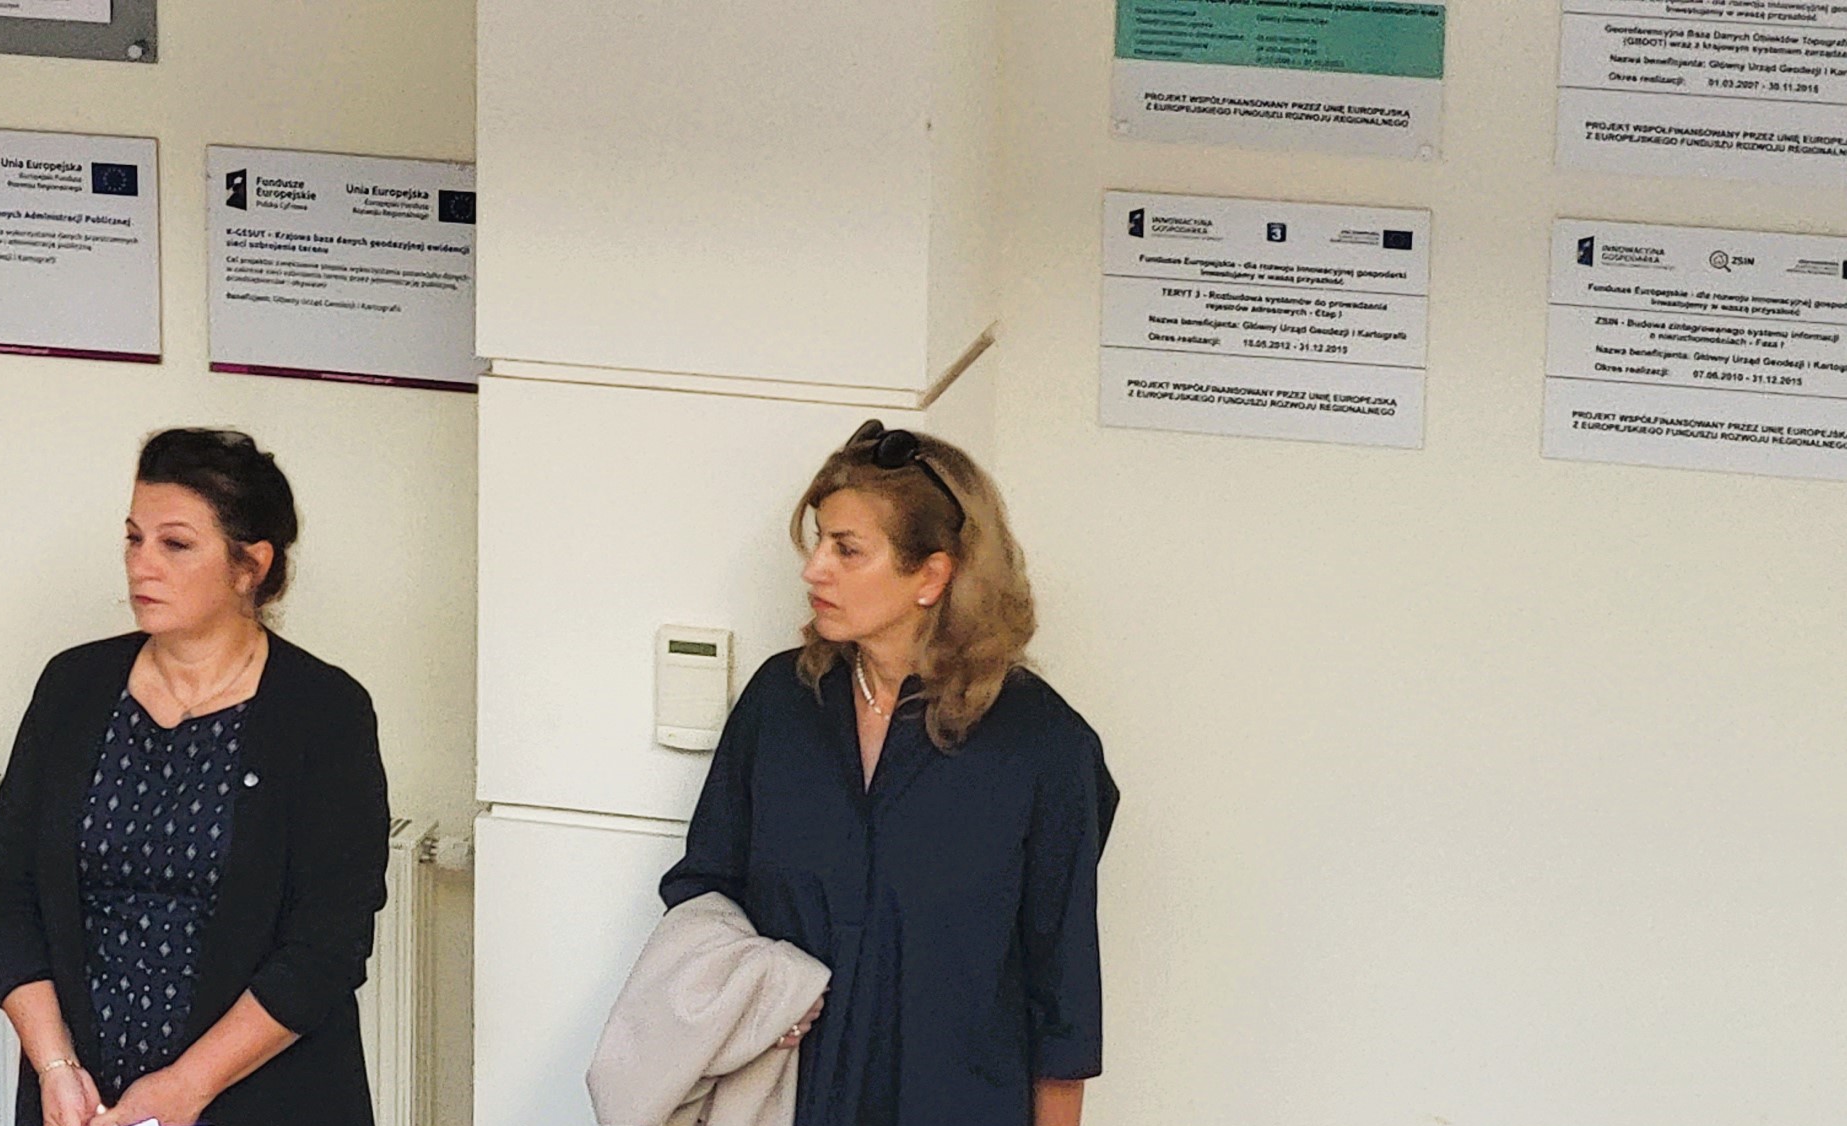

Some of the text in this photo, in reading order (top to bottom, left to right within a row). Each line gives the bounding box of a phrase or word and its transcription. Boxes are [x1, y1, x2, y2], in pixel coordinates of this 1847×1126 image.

[1144, 91, 1187, 103] PROJEKT
[1291, 101, 1321, 112] PRZEZ
[1153, 102, 1231, 116] EUROPEJSKIEGO
[1232, 107, 1283, 120] FUNDUSZU
[1284, 111, 1331, 123] ROZWOJU
[1332, 114, 1408, 128] REGIONALNEGO
[1585, 120, 1630, 132] PROJEKT
[1742, 130, 1774, 141] PRZEZ
[1594, 131, 1678, 146] EUROPEJSKIEGO
[1679, 136, 1733, 149] FUNDUSZU
[1735, 140, 1785, 153] ROZWOJU
[0, 157, 82, 174] Unia Europejska
[255, 175, 304, 189] Fundusze
[345, 183, 429, 201] Unia Europejska
[255, 186, 316, 202] Europejskie
[1271, 227, 1282, 240] 3
[1731, 255, 1754, 266] ZSIN
[1127, 379, 1170, 390] PROJEKT
[1276, 389, 1306, 400] PRZEZ
[1136, 389, 1215, 403] EUROPEJSKIEGO
[1217, 395, 1267, 407] FUNDUSZU
[1269, 399, 1316, 411] ROZWOJU
[1319, 402, 1395, 416] REGIONALNEGO
[1571, 410, 1616, 421] PROJEKT
[1727, 421, 1758, 432] PRZEZ
[1580, 420, 1663, 435] EUROPEJSKIEGO
[1665, 427, 1718, 440] FUNDUSZU
[1720, 431, 1769, 443] ROZWOJU
